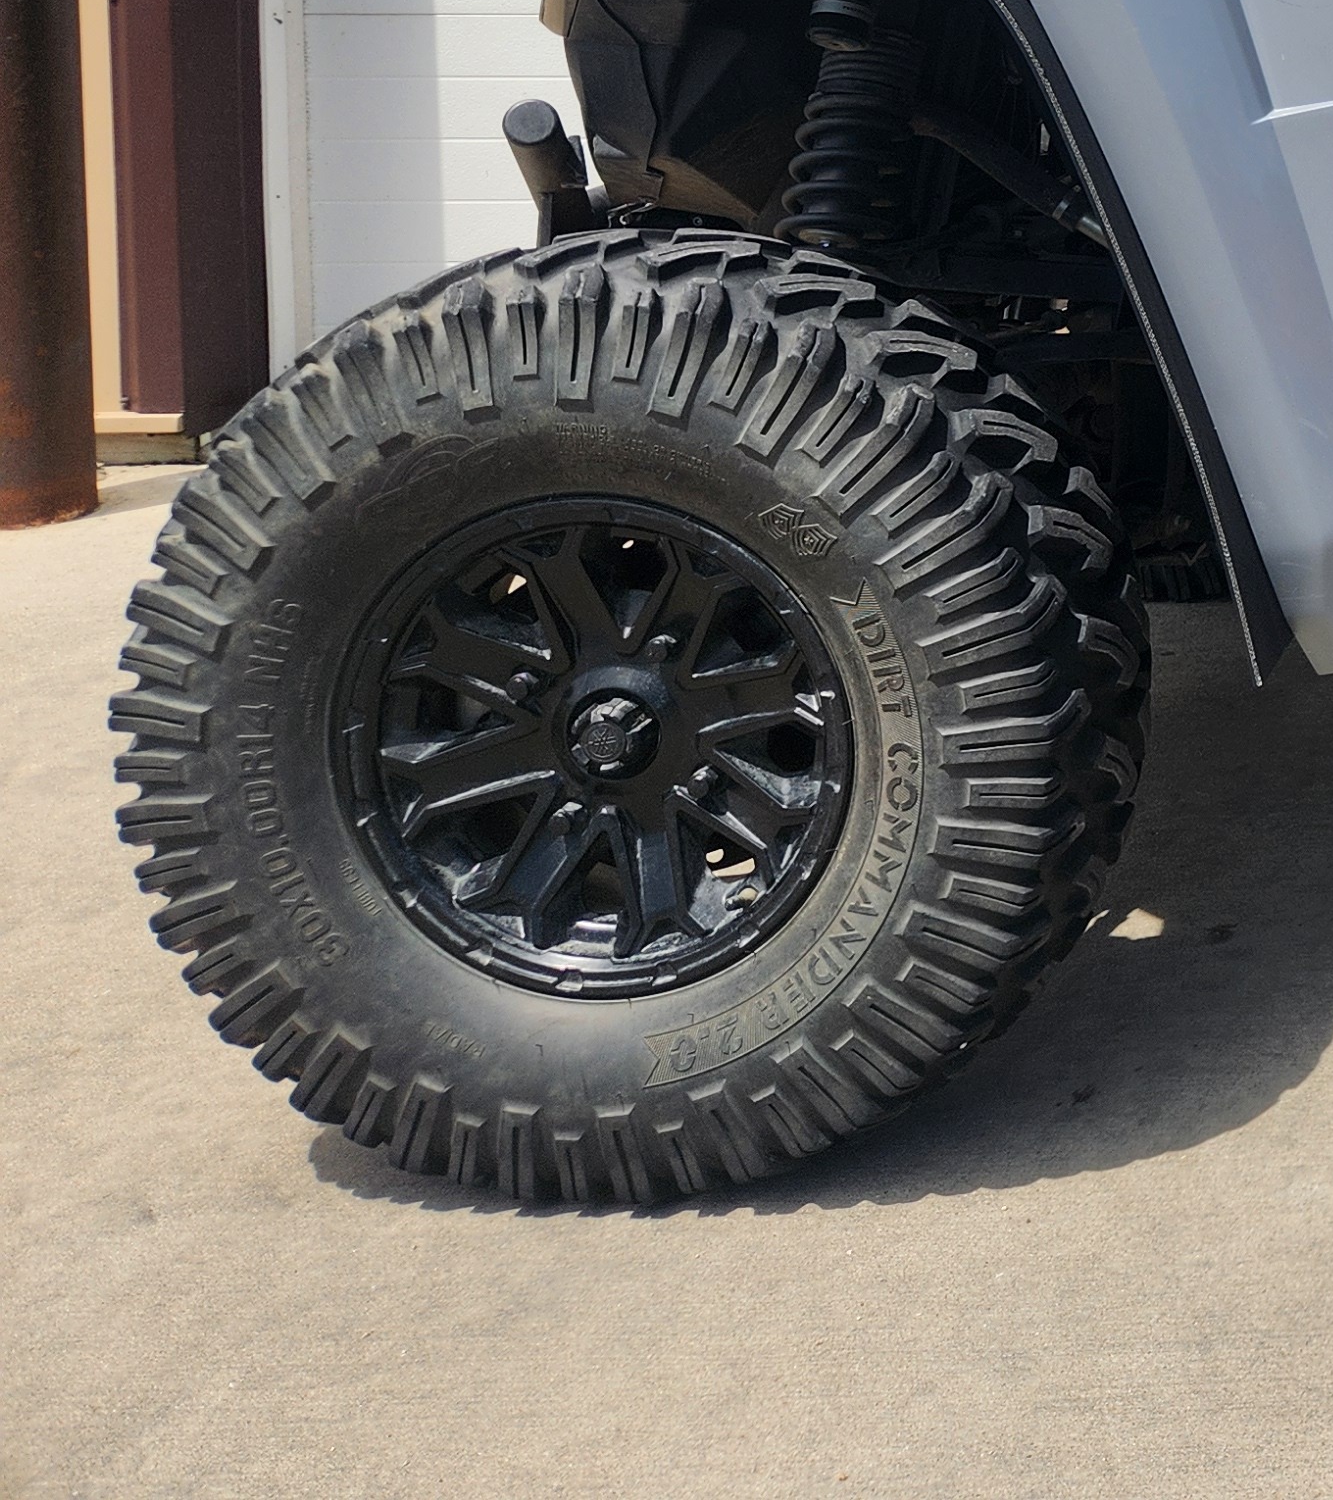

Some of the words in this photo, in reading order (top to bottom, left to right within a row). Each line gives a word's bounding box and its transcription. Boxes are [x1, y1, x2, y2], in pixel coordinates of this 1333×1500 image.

[853, 615, 912, 719] DIRT
[236, 701, 350, 967] 30X10.00R14
[754, 742, 919, 1032] COMMANDER
[669, 1013, 743, 1073] 2.0
